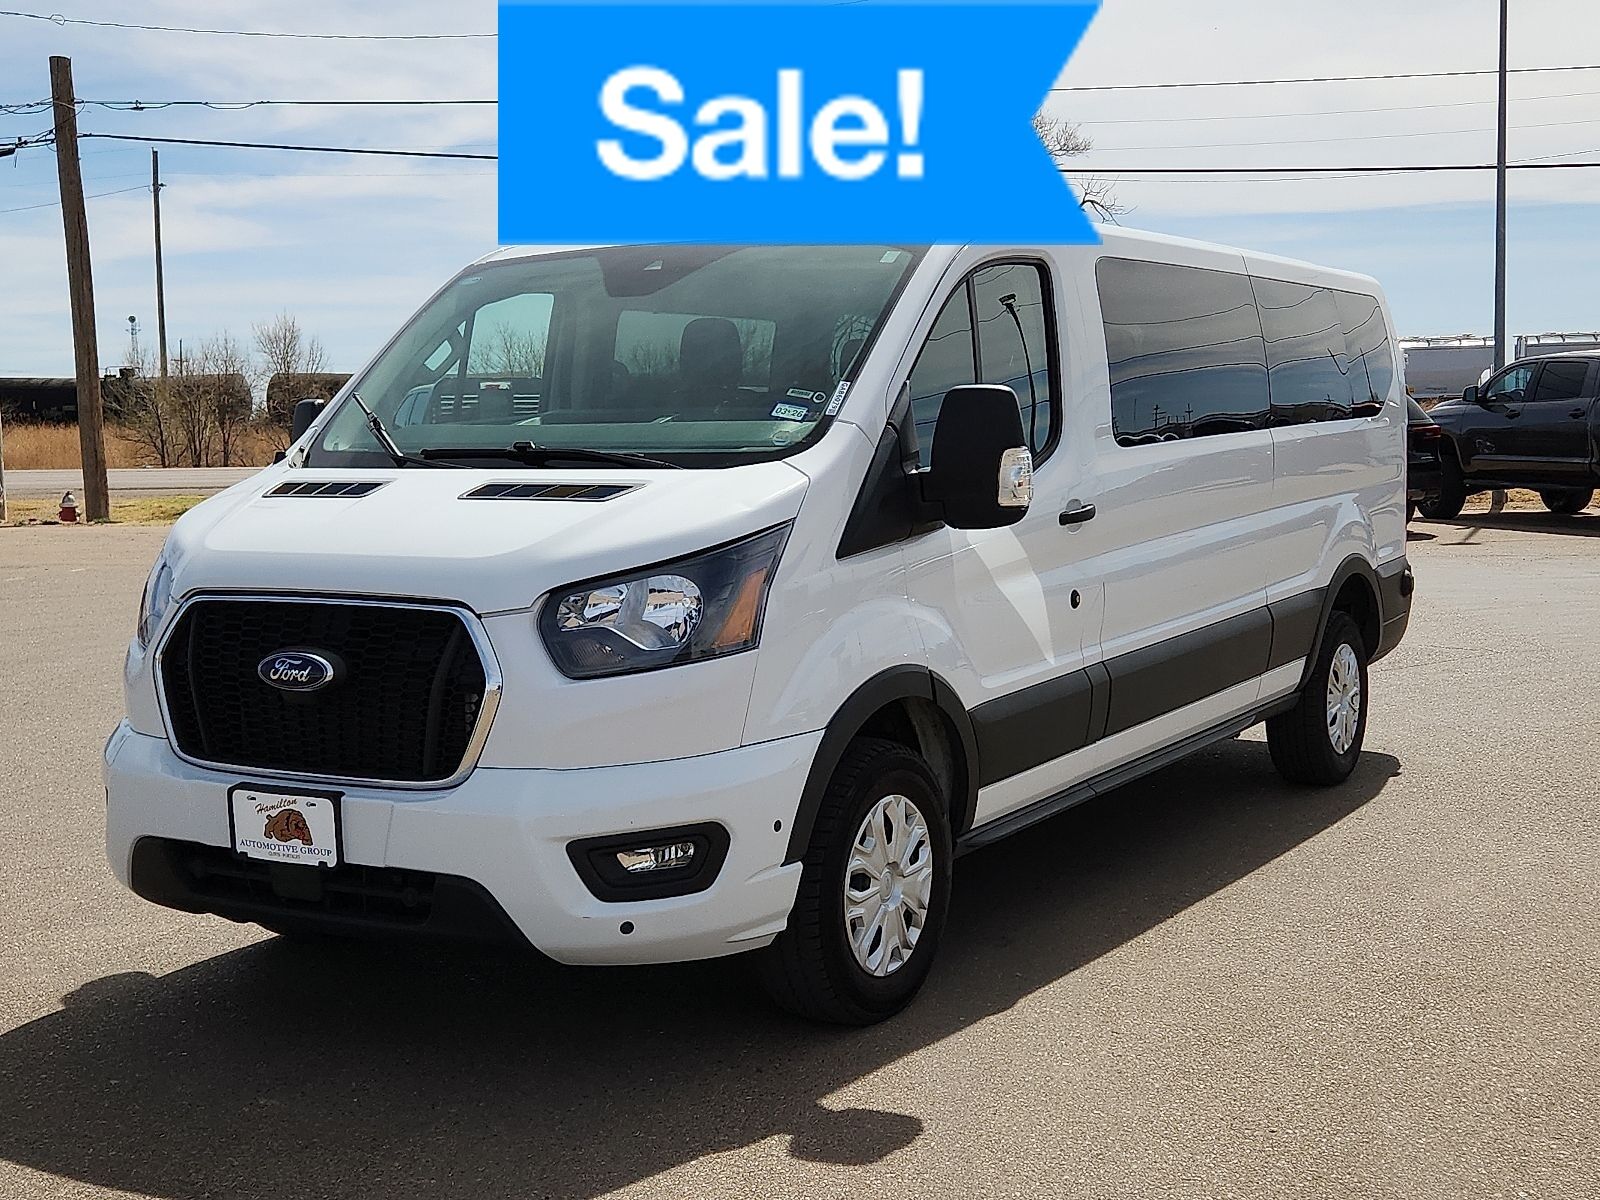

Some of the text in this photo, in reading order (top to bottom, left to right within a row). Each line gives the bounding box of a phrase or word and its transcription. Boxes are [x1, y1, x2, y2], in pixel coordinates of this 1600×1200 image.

[269, 657, 312, 682] Ford
[254, 798, 298, 815] Hamilton
[239, 839, 299, 854] AUTOMOTIVE
[300, 846, 333, 857] GROUP
